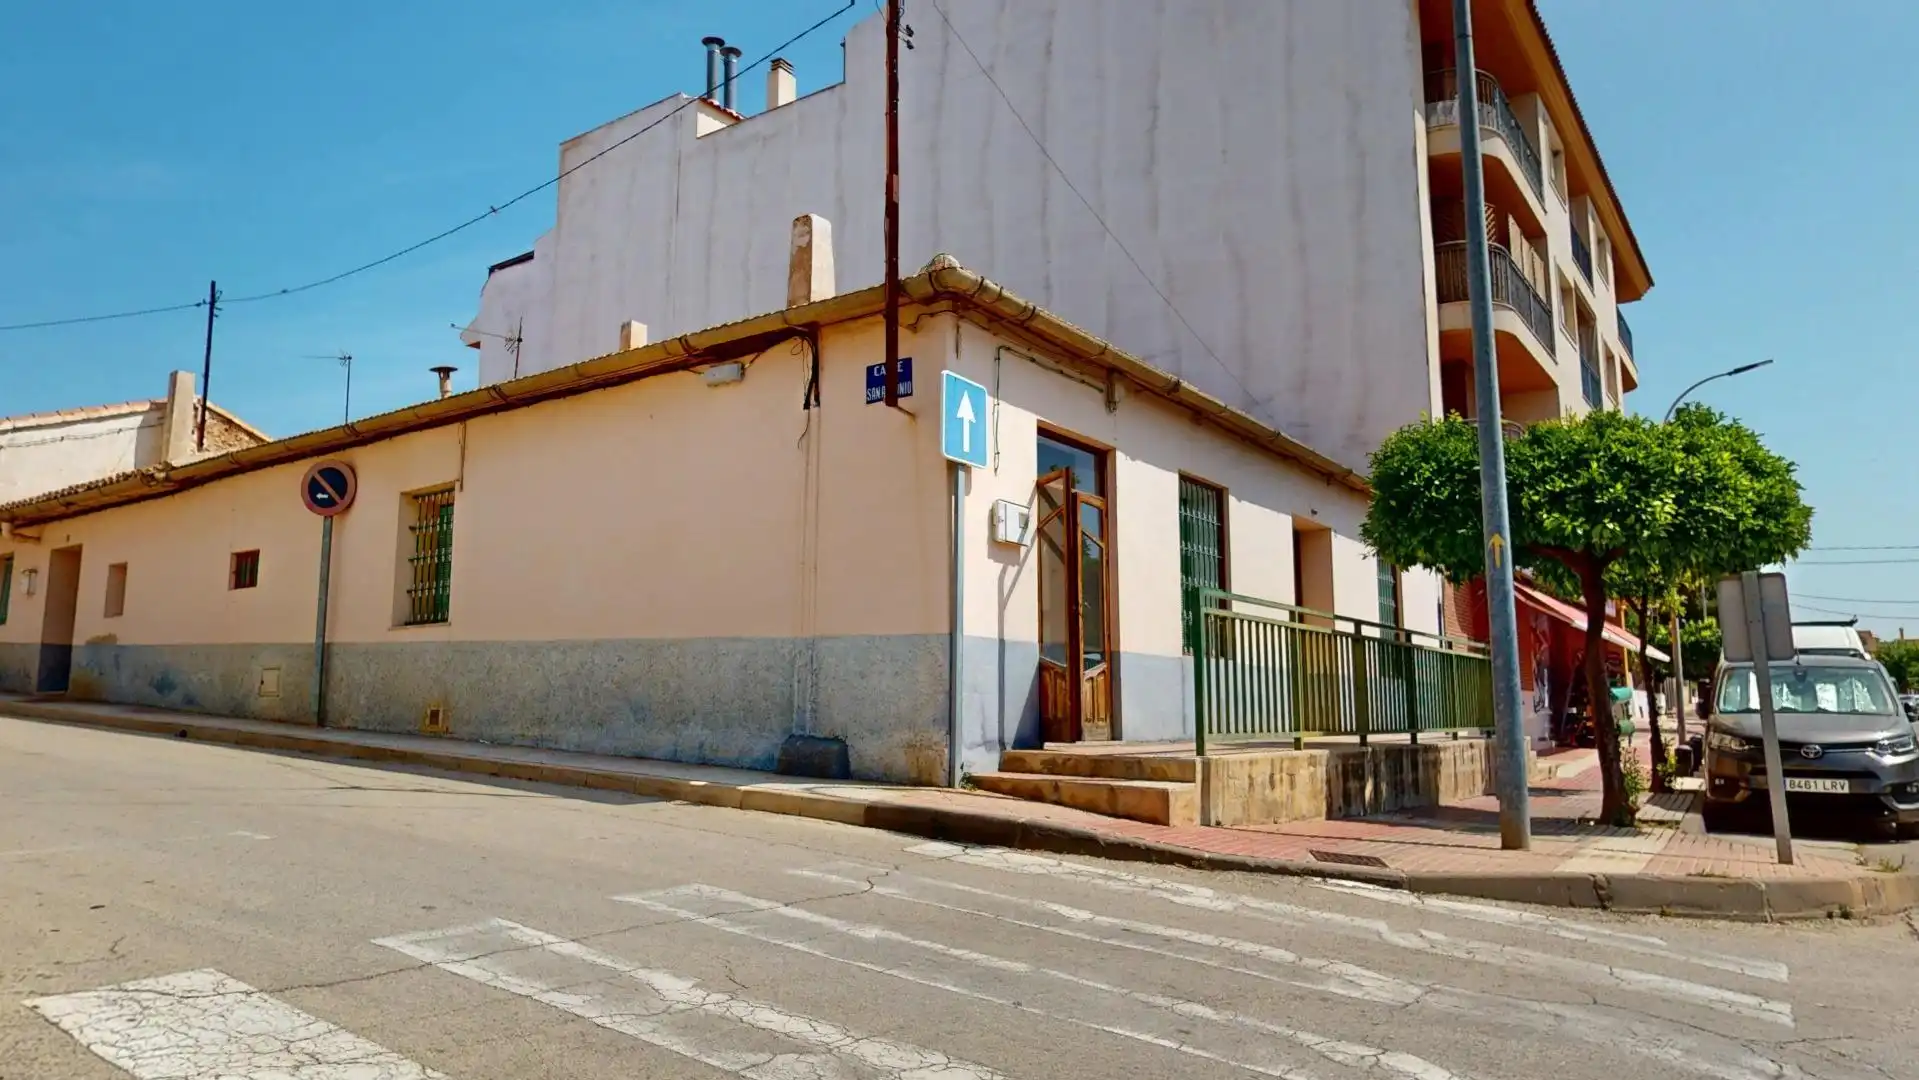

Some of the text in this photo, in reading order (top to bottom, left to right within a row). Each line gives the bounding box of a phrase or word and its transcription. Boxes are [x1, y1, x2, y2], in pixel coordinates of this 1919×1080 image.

[873, 360, 904, 377] CAE
[867, 381, 912, 401] SAN ANIO
[1822, 780, 1846, 791] LRV
